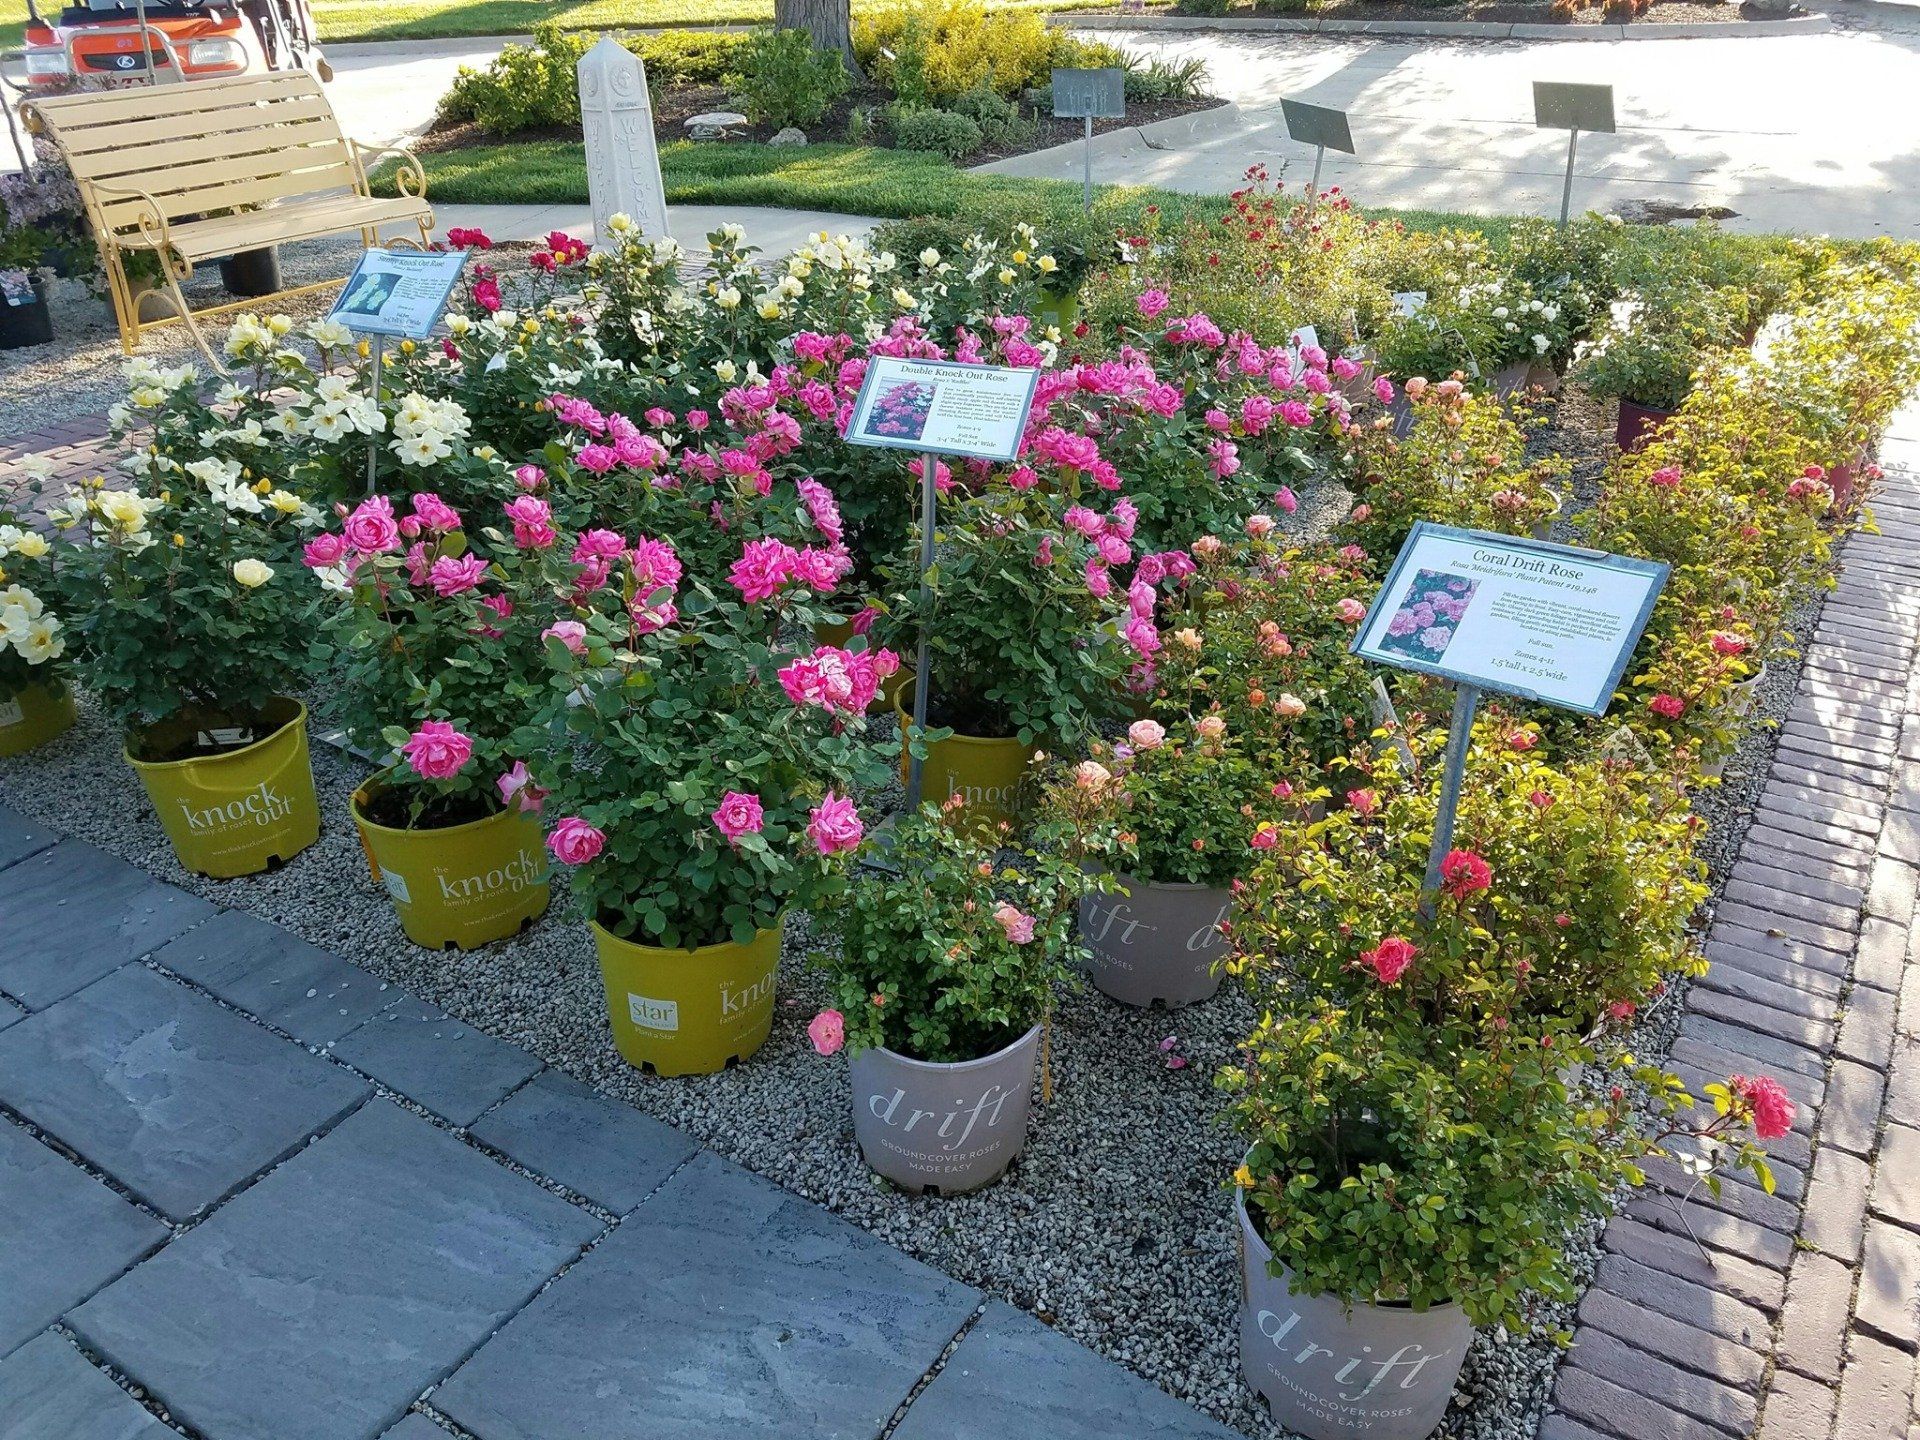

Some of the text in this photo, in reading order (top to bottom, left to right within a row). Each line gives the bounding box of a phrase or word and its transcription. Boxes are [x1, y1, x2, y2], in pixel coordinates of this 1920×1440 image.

[900, 365, 1008, 382] Double Knock Out Rose
[1473, 549, 1584, 580] Coral Drift Rose
[1450, 560, 1469, 570] Rosa
[1516, 572, 1537, 583] Plant
[1537, 576, 1564, 588] Patent
[1565, 583, 1598, 595] #19,148
[1527, 638, 1541, 646] Full
[1514, 650, 1554, 665] Zones 4-11
[181, 781, 280, 829] knock
[255, 795, 292, 826] out
[218, 825, 227, 833] of
[433, 866, 448, 874] the
[437, 849, 533, 899] knock
[443, 897, 471, 908] family
[1106, 954, 1133, 971] ROSES
[720, 980, 735, 990] the
[721, 970, 774, 1015] kno
[632, 1000, 674, 1021] star
[720, 1010, 745, 1025] family
[868, 1083, 1018, 1151] drift
[881, 1138, 1000, 1163] GROUNDCOVER ROSES
[908, 1161, 972, 1173] MADE EASY
[1257, 1308, 1449, 1402] drift
[1267, 1362, 1414, 1419] GROUNDCOVER ROSES
[1296, 1399, 1373, 1430] MADE EASY
